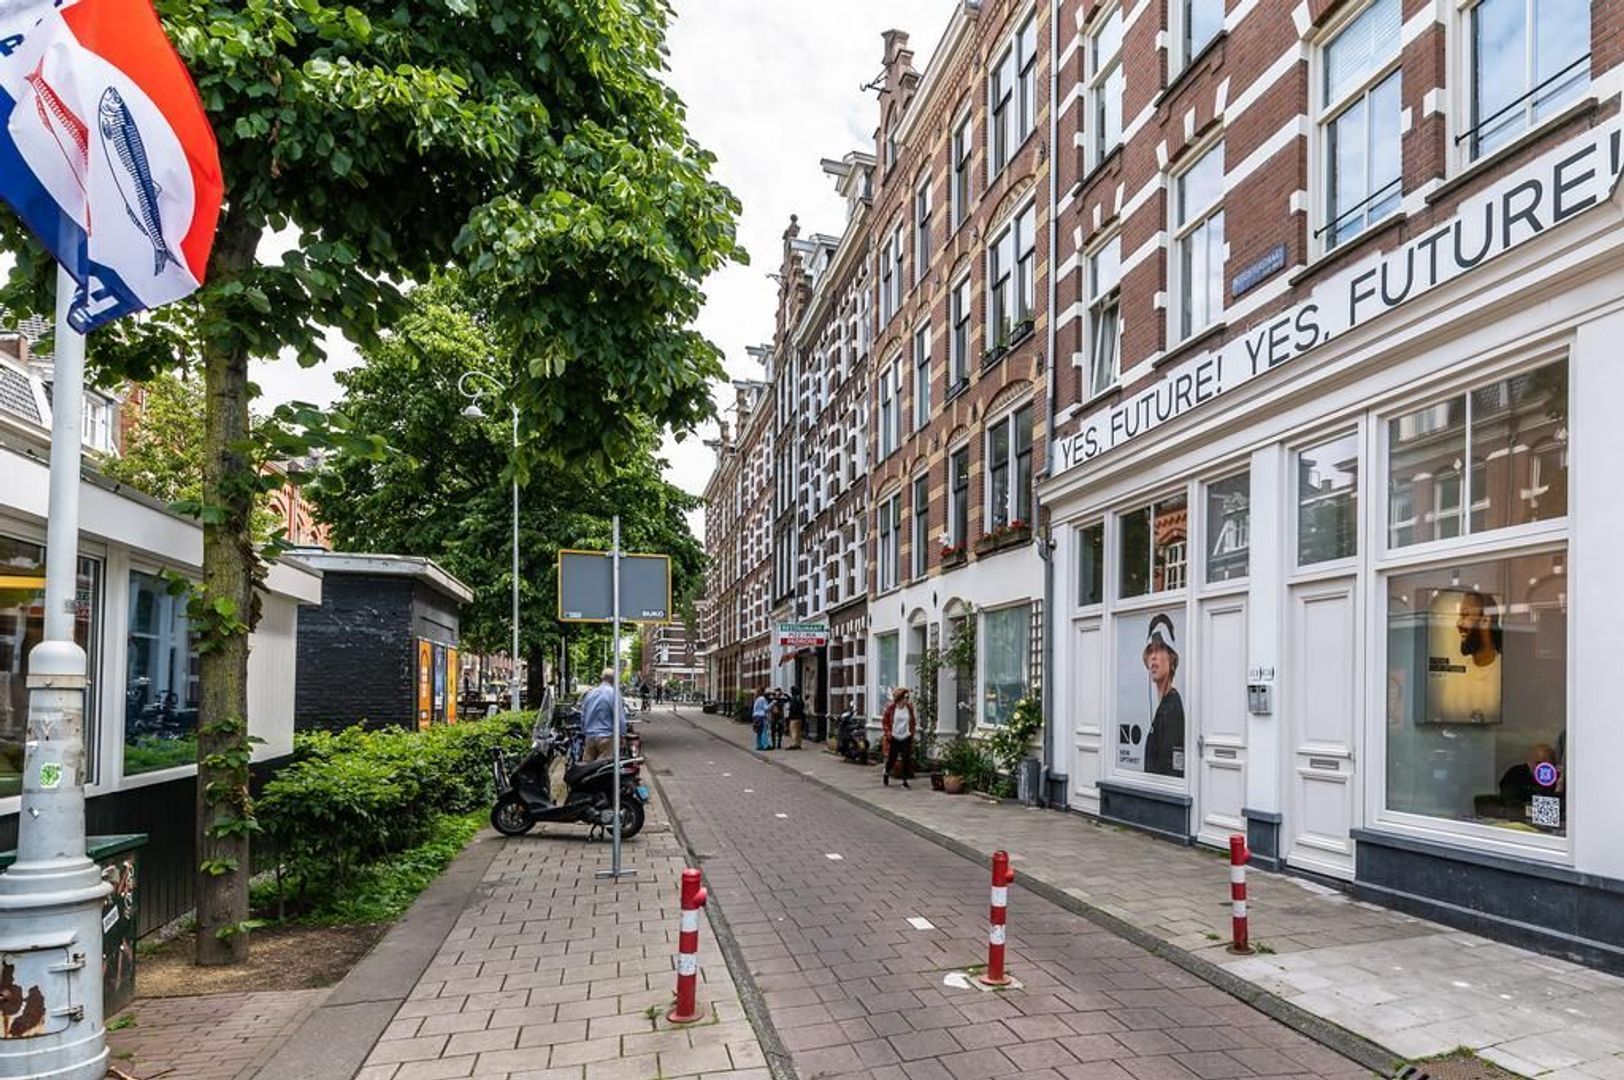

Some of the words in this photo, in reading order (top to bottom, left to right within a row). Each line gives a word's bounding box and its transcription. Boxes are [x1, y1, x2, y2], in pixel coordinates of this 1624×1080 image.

[1062, 426, 1103, 469] YES,
[1110, 354, 1222, 447] FUTURE!
[1245, 304, 1330, 377] YES,
[1119, 724, 1142, 745] NO
